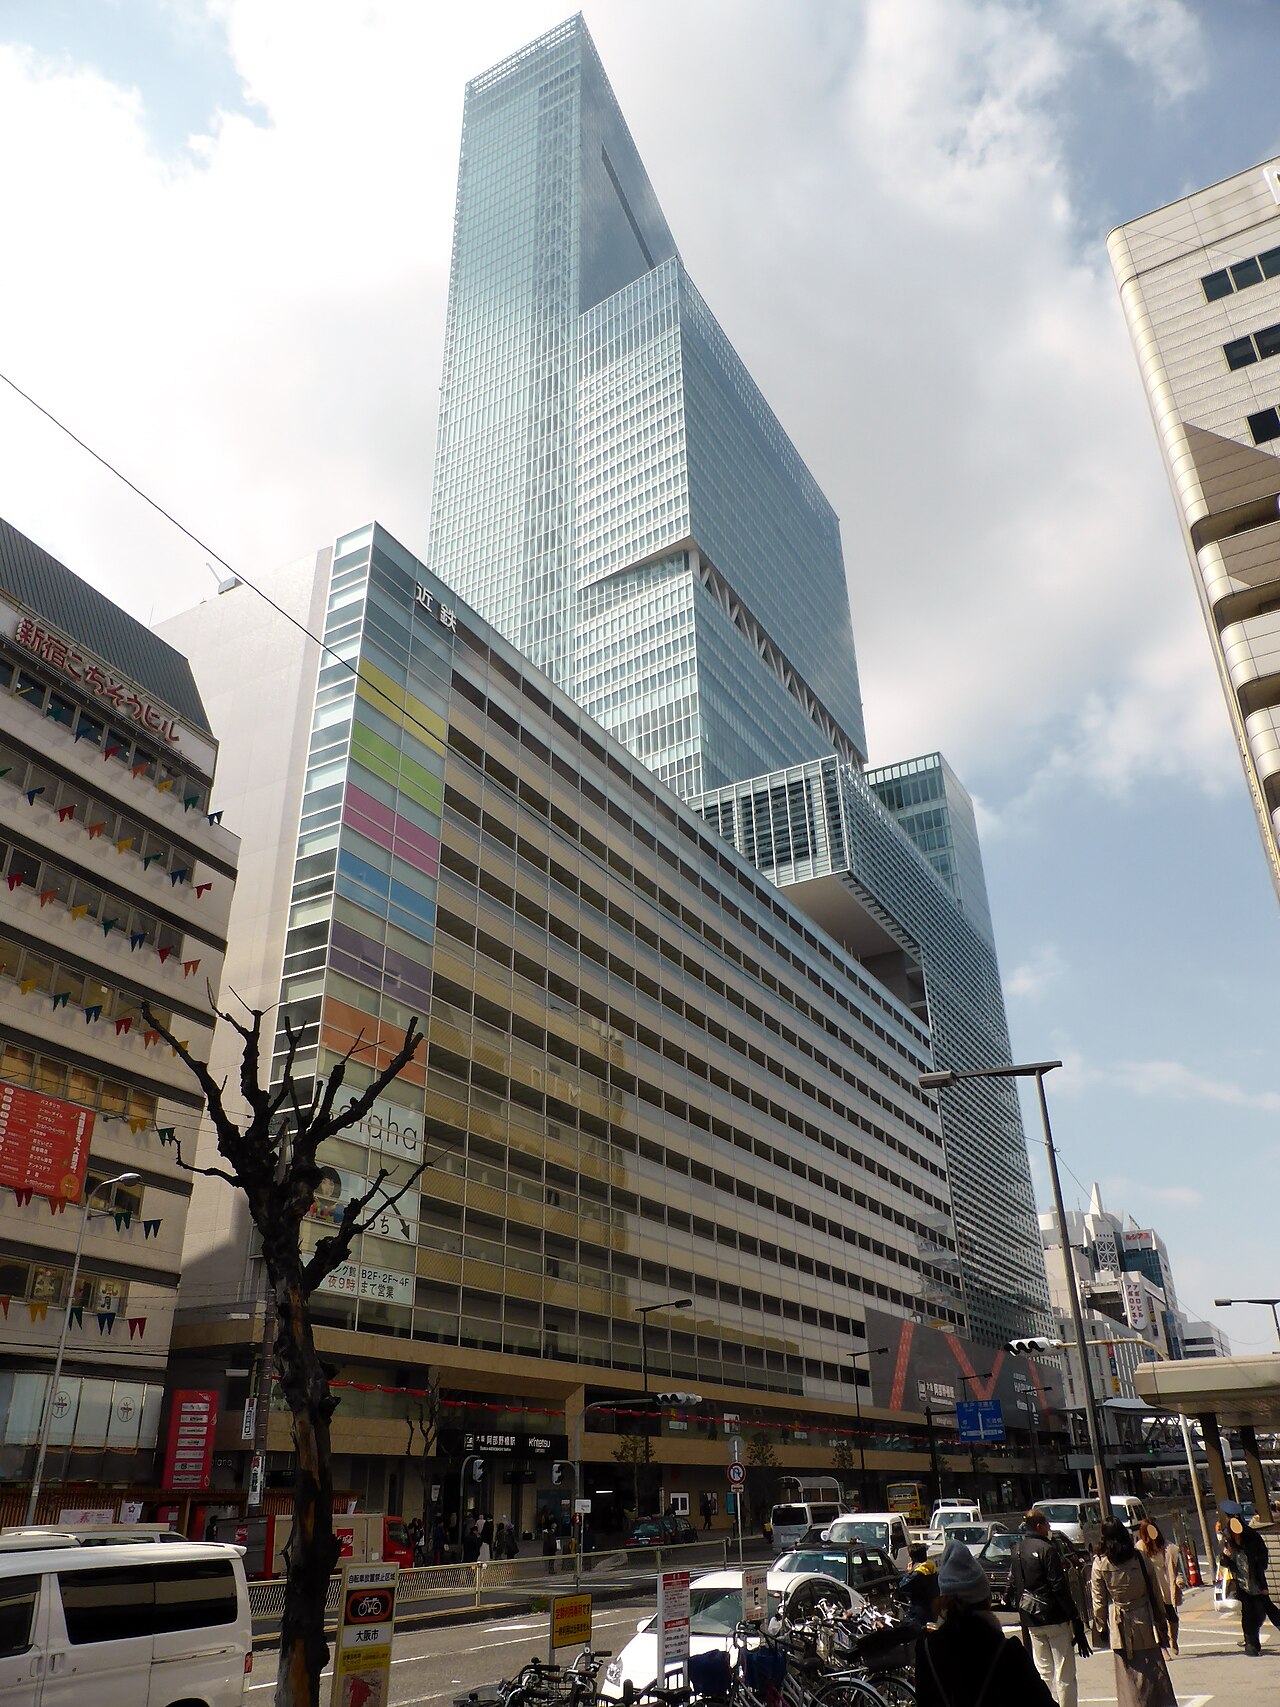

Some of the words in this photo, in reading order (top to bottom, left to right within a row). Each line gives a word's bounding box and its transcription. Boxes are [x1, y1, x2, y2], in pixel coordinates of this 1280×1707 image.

[415, 580, 457, 634] 近鉄
[328, 1274, 356, 1292] 夜9時
[360, 1280, 394, 1299] まで営業
[355, 1629, 379, 1642] 大阪市
